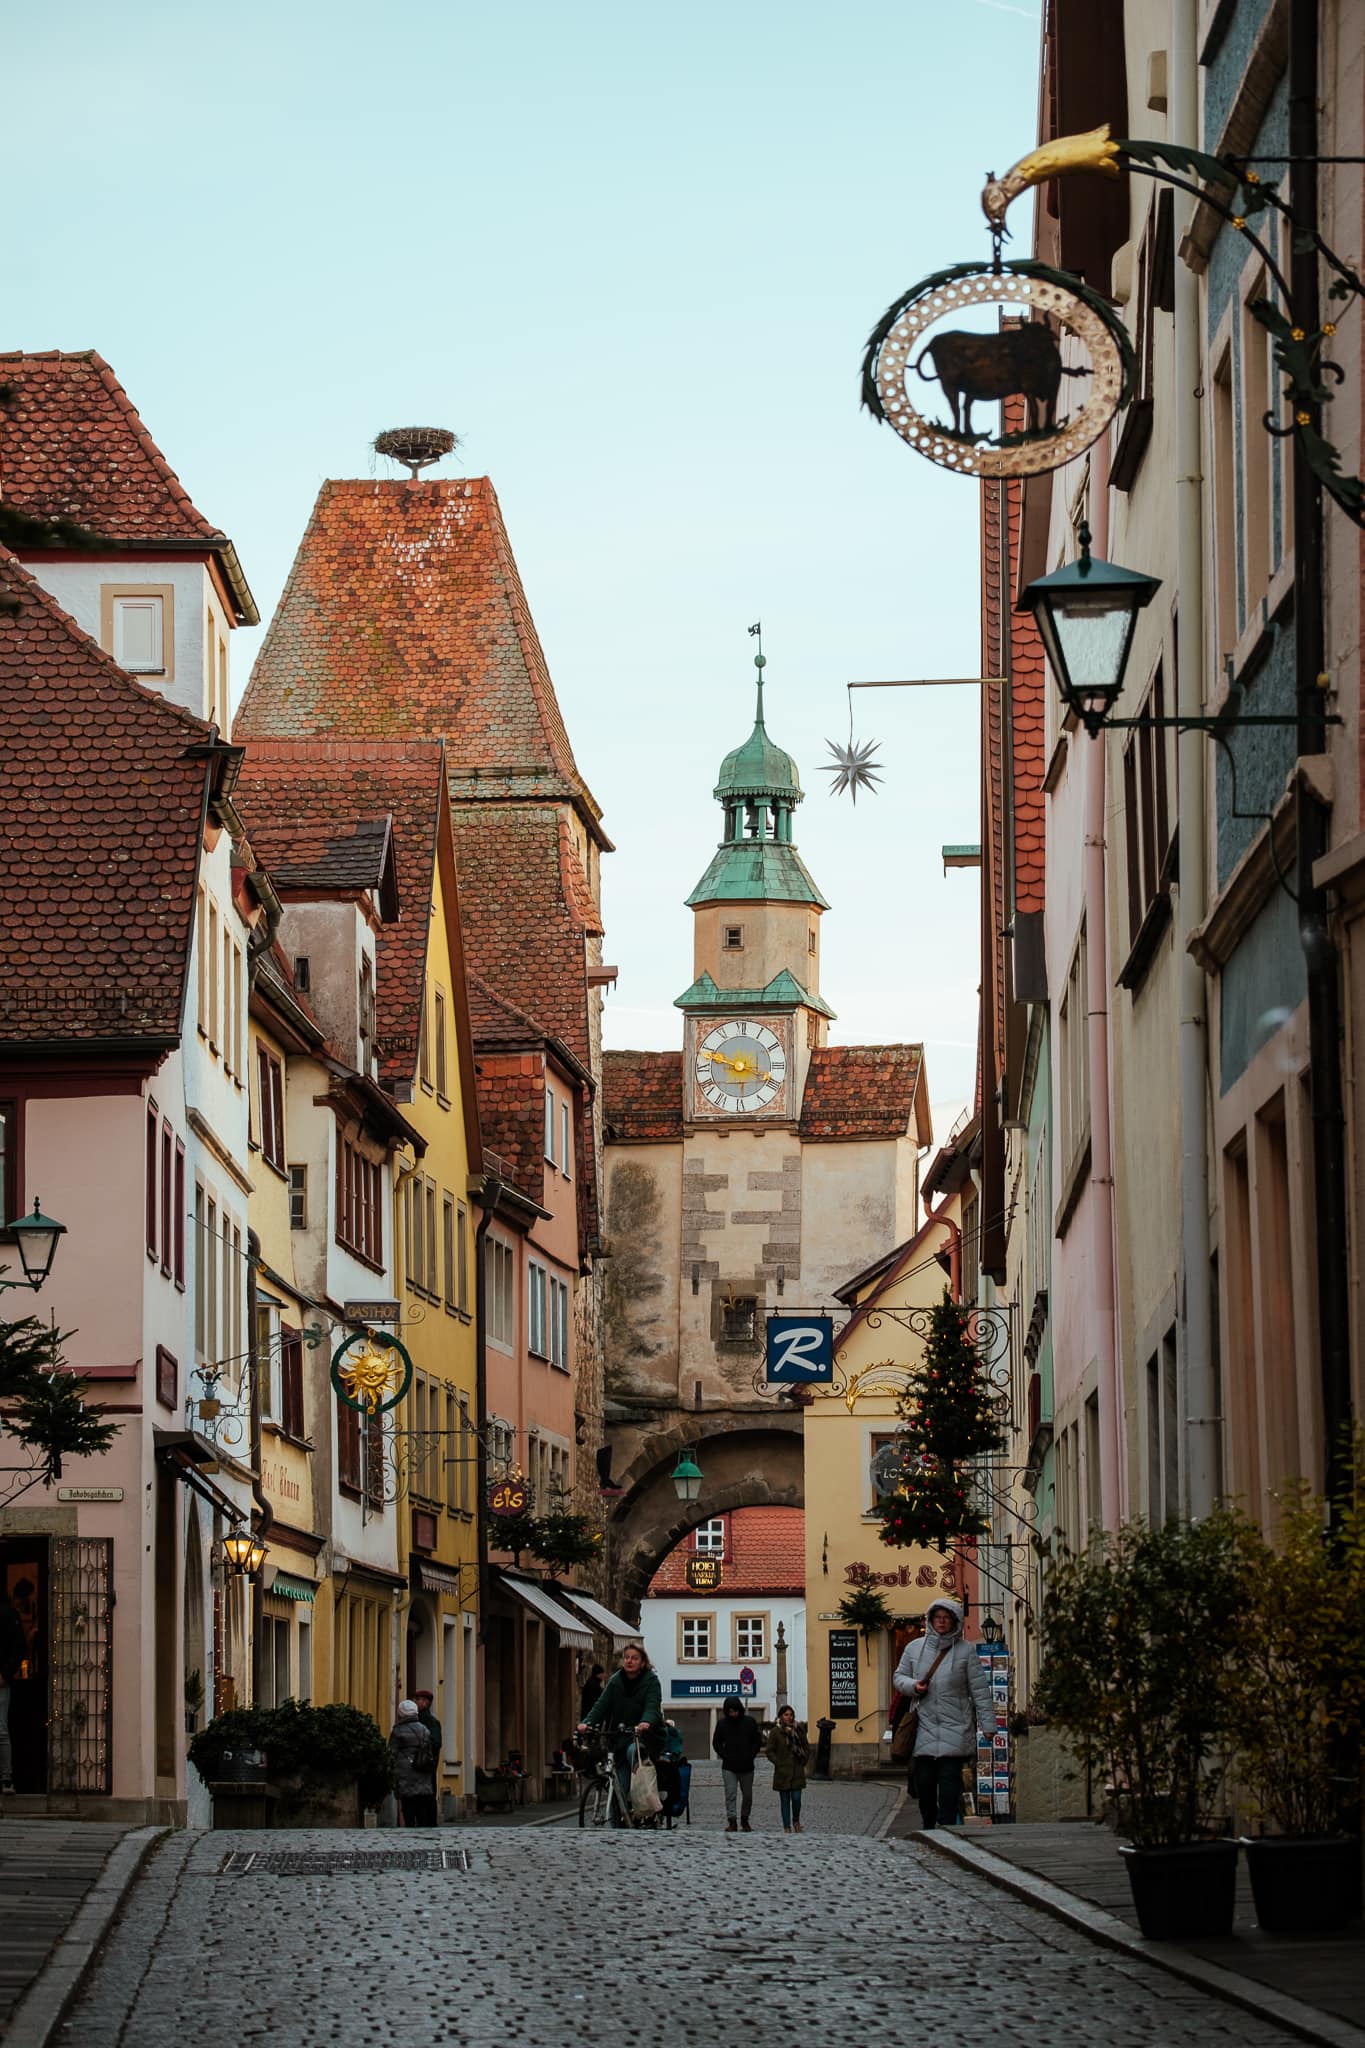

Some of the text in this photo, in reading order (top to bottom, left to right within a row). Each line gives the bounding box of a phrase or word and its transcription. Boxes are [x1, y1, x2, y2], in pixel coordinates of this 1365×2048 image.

[347, 1305, 398, 1319] GASTHOF
[915, 1564, 937, 1588] &
[689, 1684, 738, 1694] anno 1893
